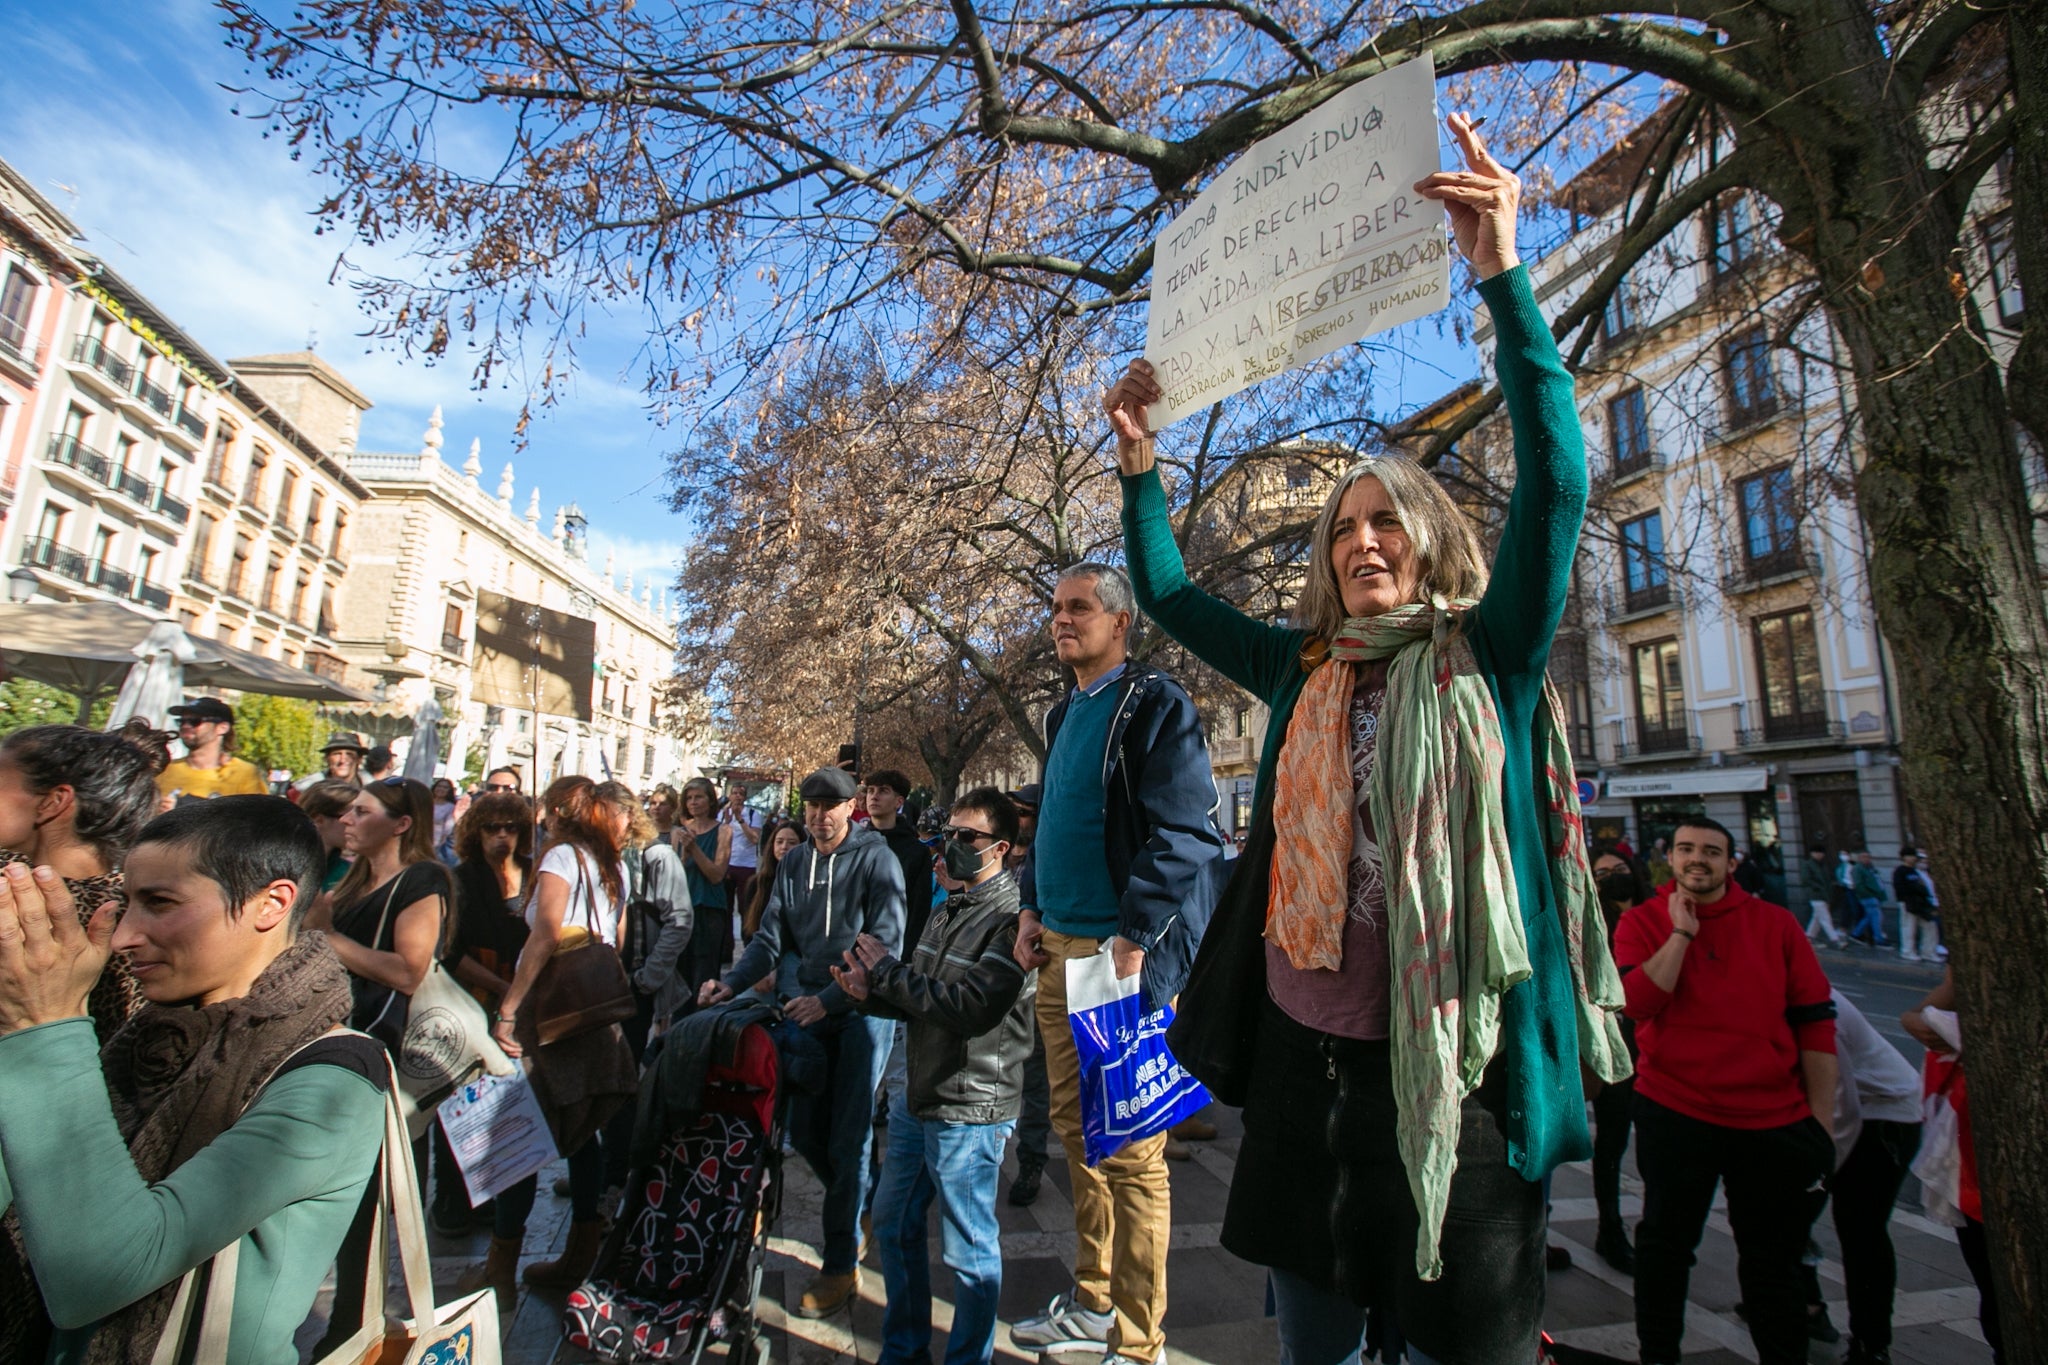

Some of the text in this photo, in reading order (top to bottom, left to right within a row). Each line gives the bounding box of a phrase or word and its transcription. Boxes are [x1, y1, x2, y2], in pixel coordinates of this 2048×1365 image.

[1162, 308, 1185, 338] LA
[1274, 246, 1299, 277] LA
[1320, 196, 1423, 257] LIBER-
[1166, 248, 1210, 297] TIENE
[1223, 182, 1339, 259] DERECHO
[1364, 161, 1385, 187] A
[1160, 351, 1193, 384] TAD
[1206, 332, 1219, 360] Y
[1235, 314, 1264, 346] LA
[1243, 356, 1257, 372] DE
[1266, 341, 1288, 362] LOS
[1295, 310, 1355, 350] DERECHOS
[1368, 277, 1440, 316] HUMANOS
[1287, 353, 1295, 365] 3
[1135, 1052, 1168, 1089] NES
